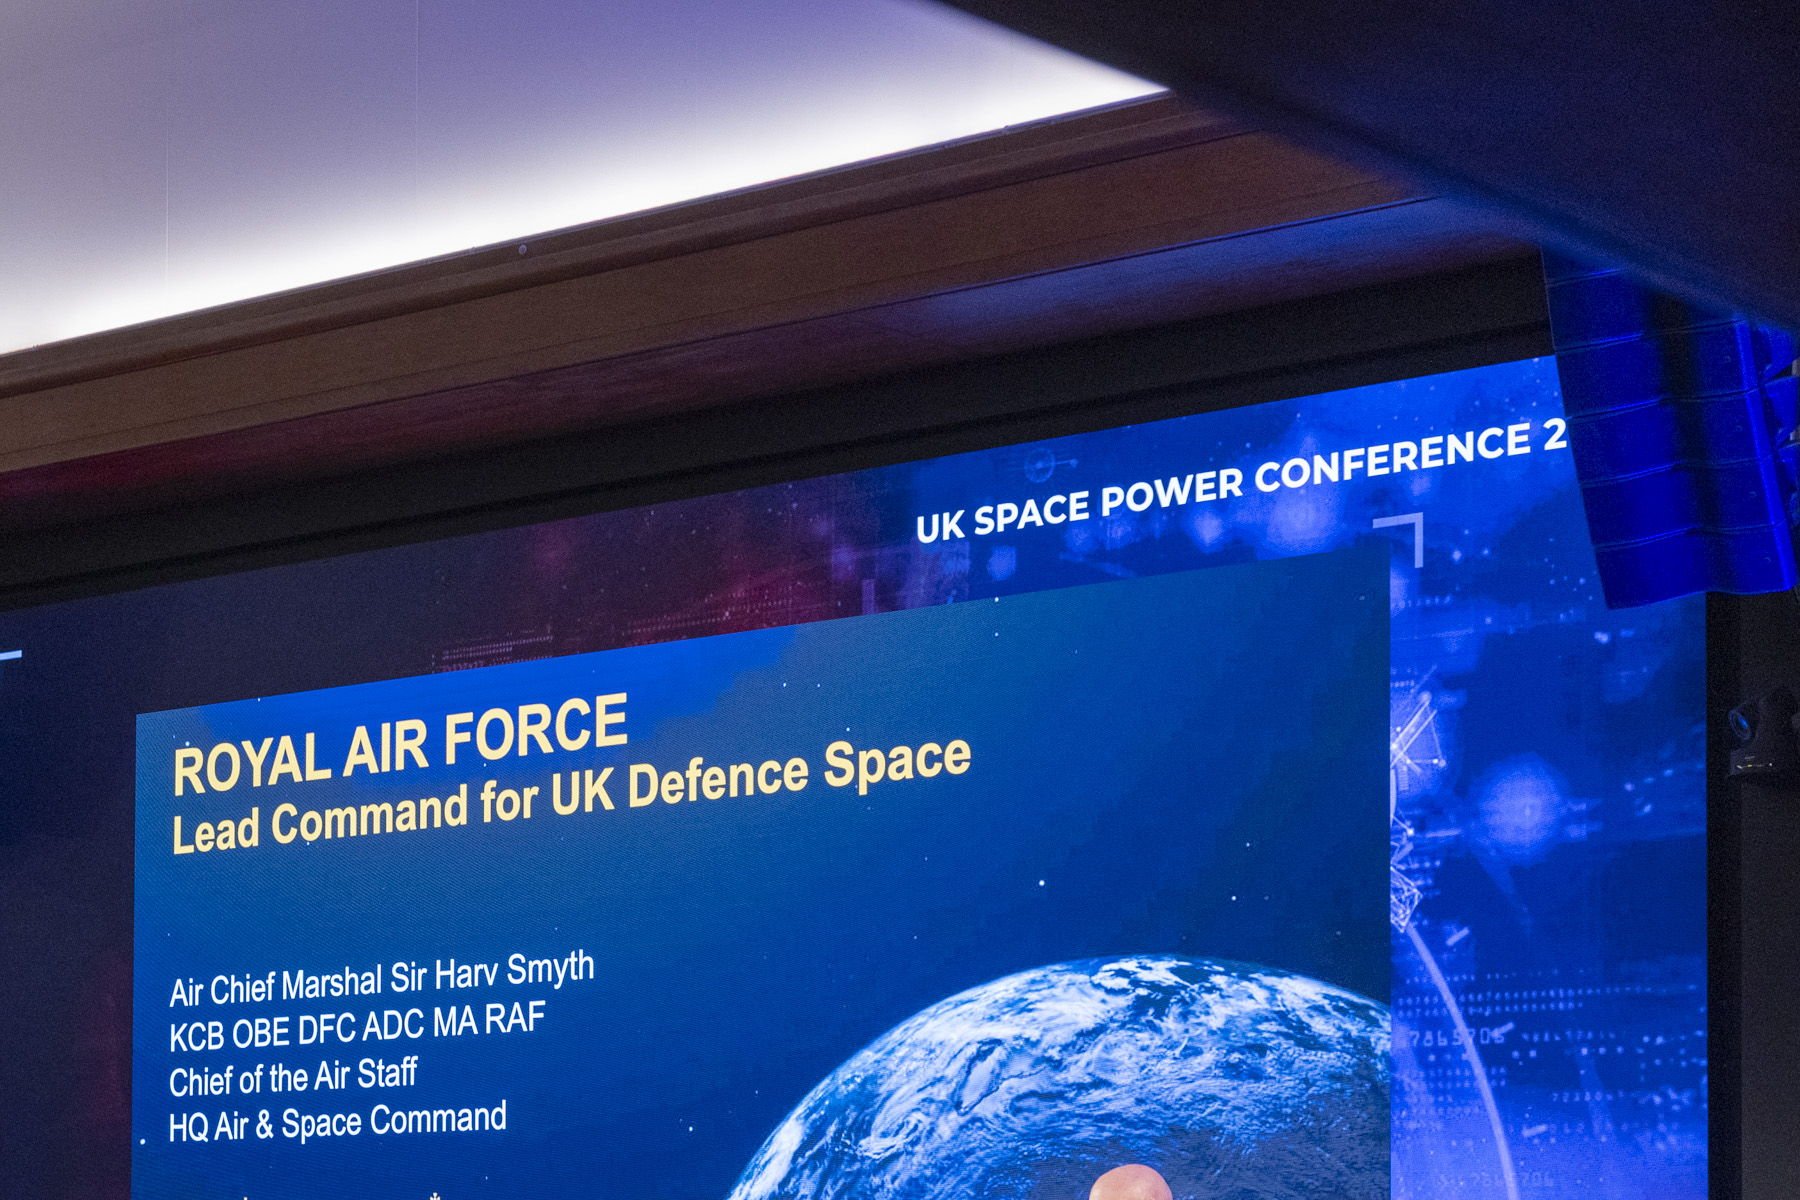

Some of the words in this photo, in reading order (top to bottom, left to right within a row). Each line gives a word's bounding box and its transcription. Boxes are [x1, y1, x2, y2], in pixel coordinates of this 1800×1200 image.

[916, 508, 965, 545] UK
[974, 491, 1090, 536] SPACE
[1101, 469, 1242, 517] POWER
[1254, 426, 1530, 493] CONFERENCE
[174, 732, 332, 796] ROYAL
[342, 718, 429, 777] AIR
[446, 692, 628, 764] FORCE
[174, 806, 259, 855] Lead
[272, 784, 468, 845] Command
[481, 780, 539, 824] for
[552, 767, 614, 816] UK
[629, 756, 808, 808] Defence
[824, 740, 972, 796] Space
[170, 979, 204, 1008] Air
[210, 972, 276, 1004] Chief
[282, 964, 382, 1000] Marshal
[390, 962, 427, 992] Sir
[436, 958, 498, 990] Harv
[506, 948, 594, 989] Smyth
[170, 1022, 224, 1052] KCB
[232, 1017, 290, 1048] OBE
[299, 1012, 356, 1045] DFC
[362, 1008, 424, 1041] ADC
[434, 1004, 478, 1038] MA
[485, 1000, 546, 1034] RAF
[170, 1065, 234, 1098] Chief
[239, 1064, 264, 1093] of
[270, 1063, 308, 1092] the
[314, 1060, 350, 1091] Air
[357, 1056, 418, 1088] Staff
[169, 1112, 208, 1143] HQ
[214, 1108, 249, 1141] Air
[256, 1109, 274, 1139] &
[282, 1105, 362, 1145] Space
[370, 1100, 507, 1135] Command
